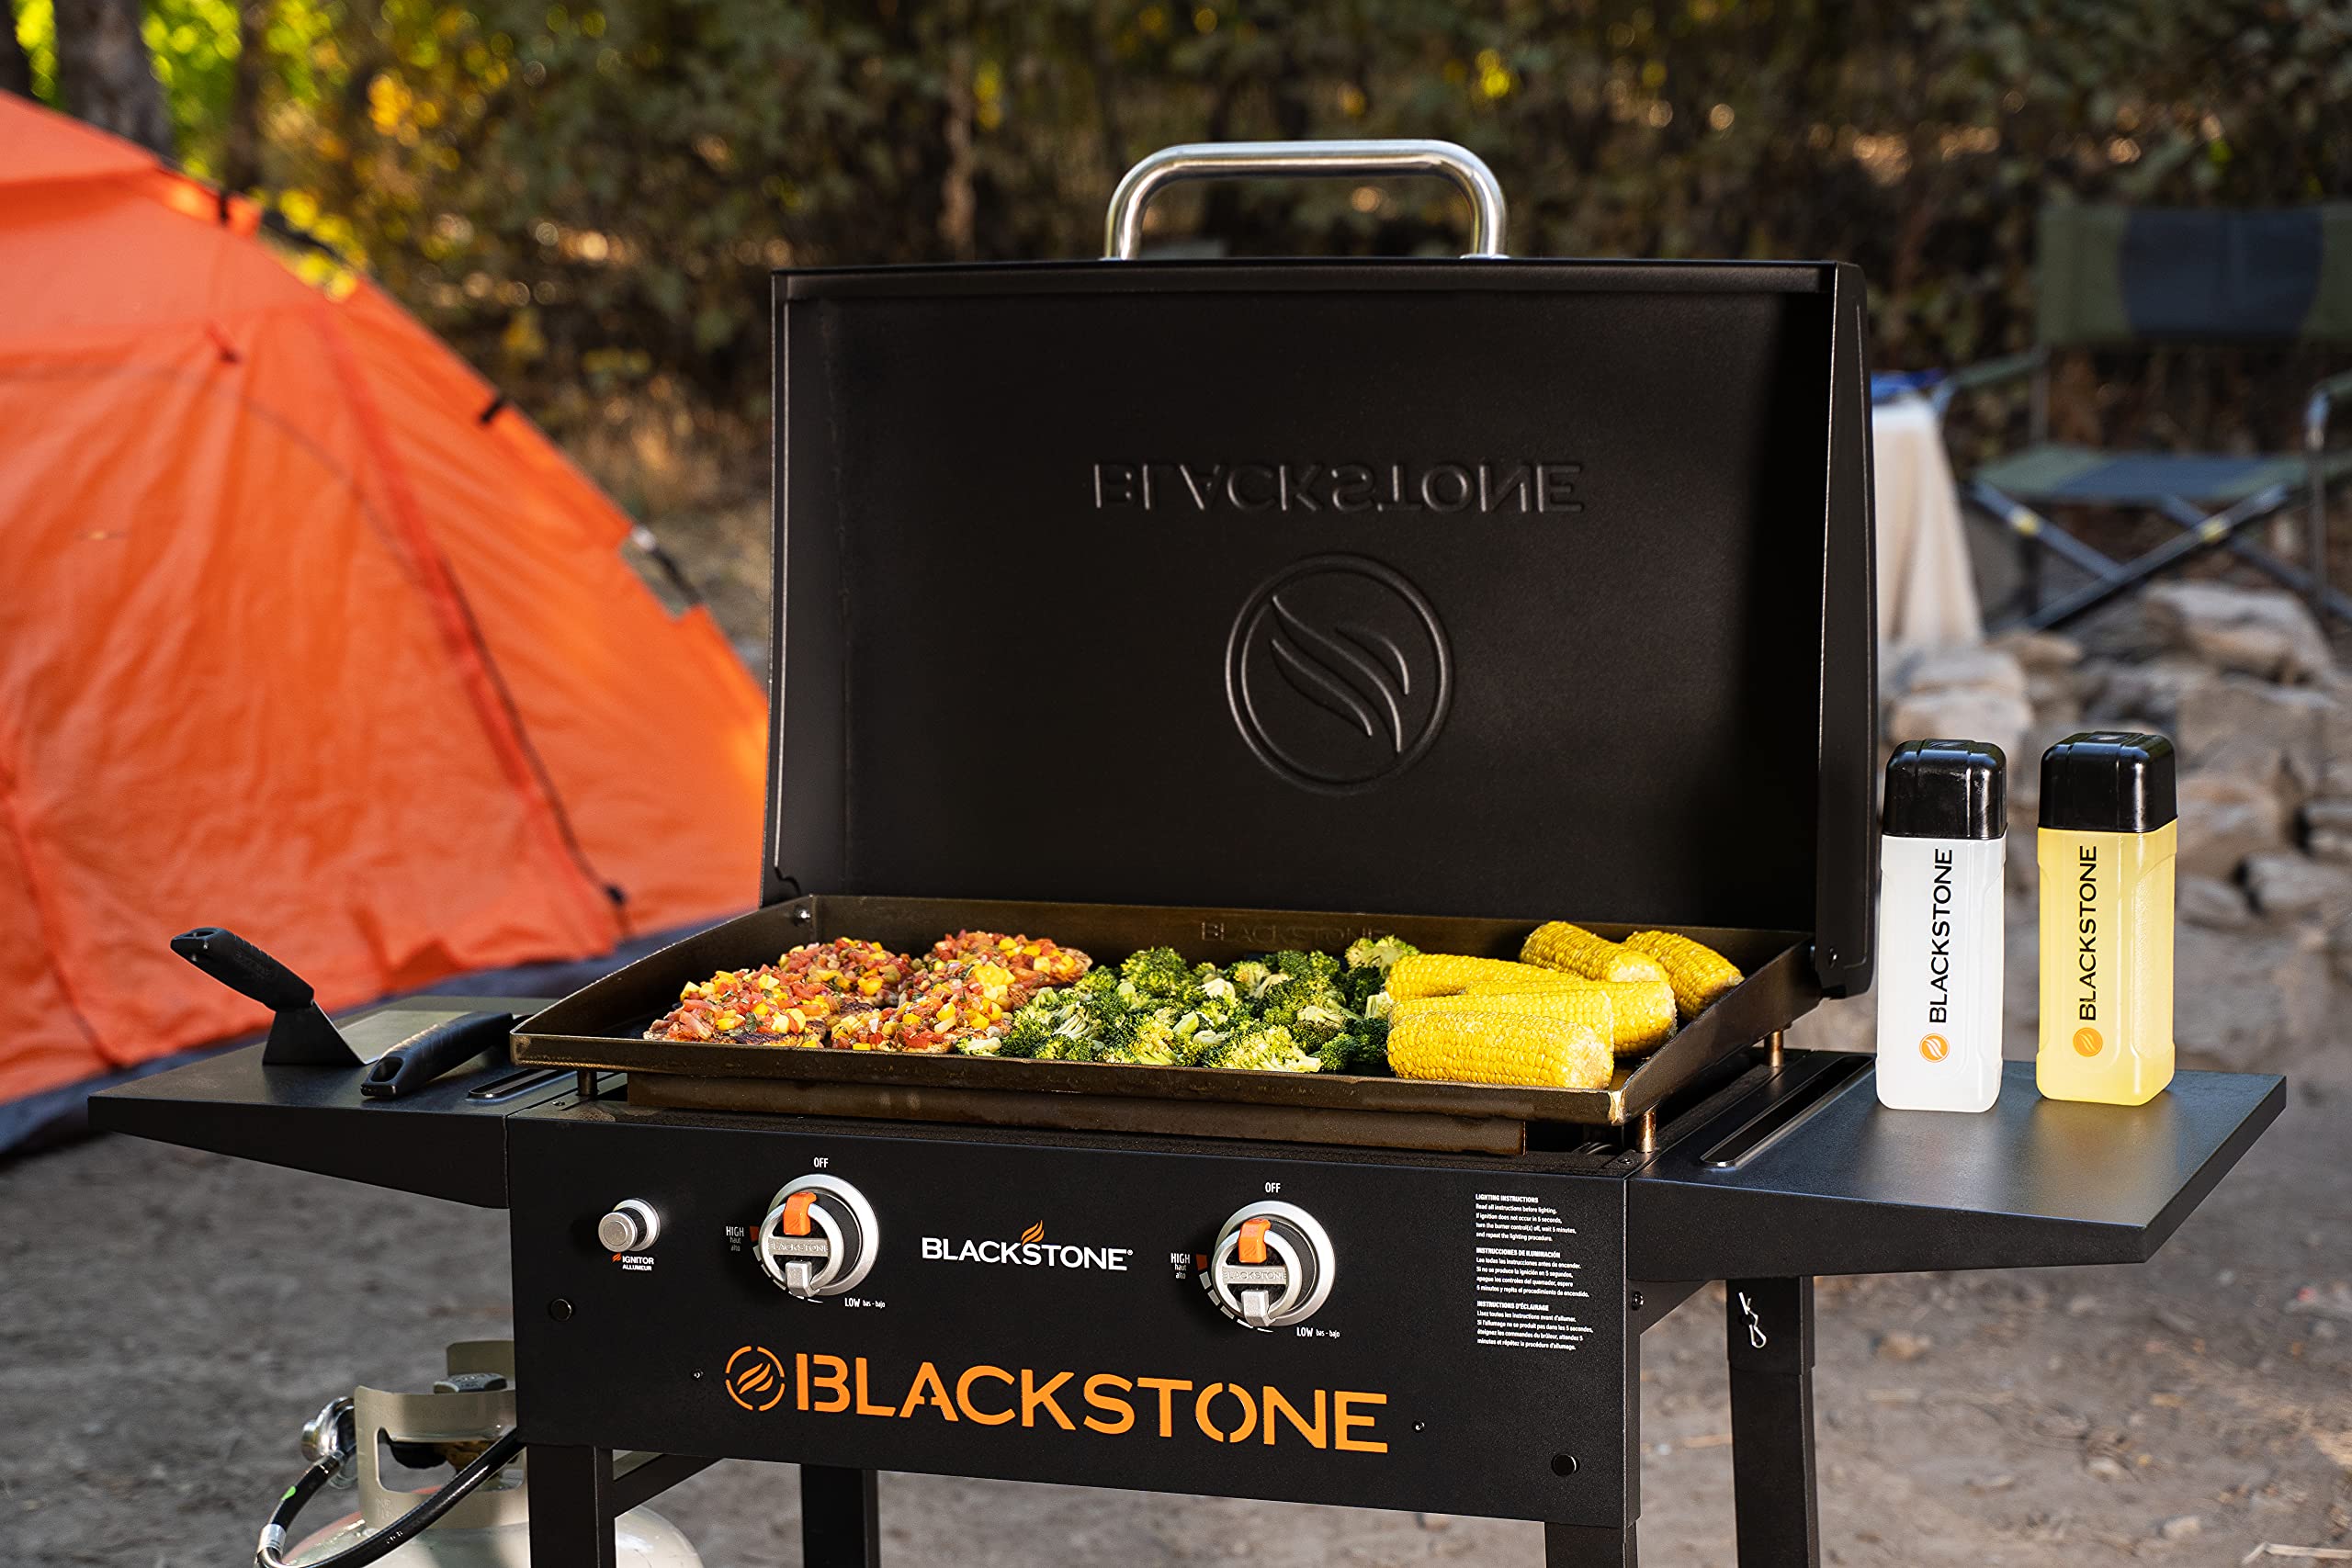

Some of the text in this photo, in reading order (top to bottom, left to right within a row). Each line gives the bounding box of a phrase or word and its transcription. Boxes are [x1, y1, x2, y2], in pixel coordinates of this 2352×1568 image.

[1929, 848, 1952, 1023] BLACKSTONE
[2079, 845, 2097, 1021] BLACKSTONE
[813, 1156, 829, 1168] OFF
[1264, 1181, 1281, 1193] OFF
[726, 1226, 744, 1237] HIGH
[622, 1255, 654, 1265] IGNITOR
[1170, 1253, 1191, 1264] HIGH
[1174, 1263, 1187, 1271] haut
[1175, 1271, 1186, 1280] alto
[844, 1297, 861, 1307] LOW
[1296, 1326, 1314, 1337] LOW
[1316, 1328, 1325, 1337] bas
[1329, 1330, 1340, 1338] bajo
[795, 1353, 1388, 1453] BLACKSTONE
